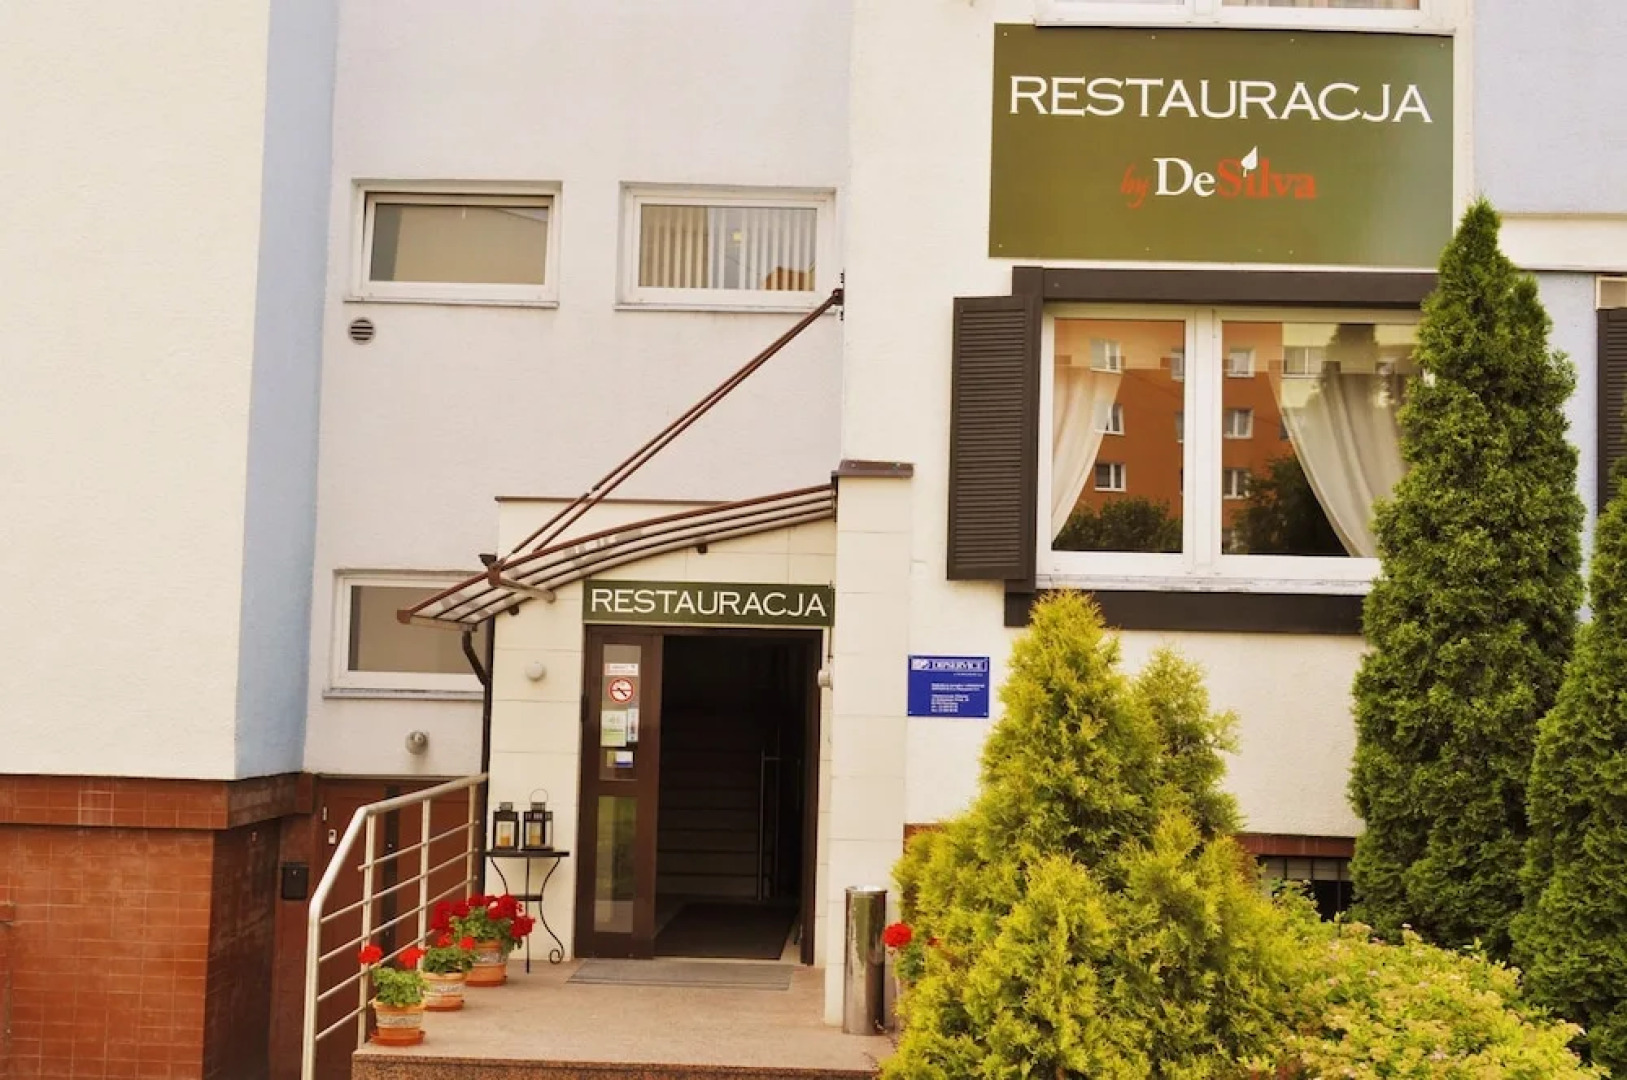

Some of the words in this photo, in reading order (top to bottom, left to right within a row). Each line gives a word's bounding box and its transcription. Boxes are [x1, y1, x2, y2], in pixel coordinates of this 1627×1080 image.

[1010, 76, 1432, 122] RESTAURACJA
[1122, 164, 1150, 208] by
[1154, 149, 1315, 198] DeSilva
[591, 588, 826, 617] RESTAURACJA
